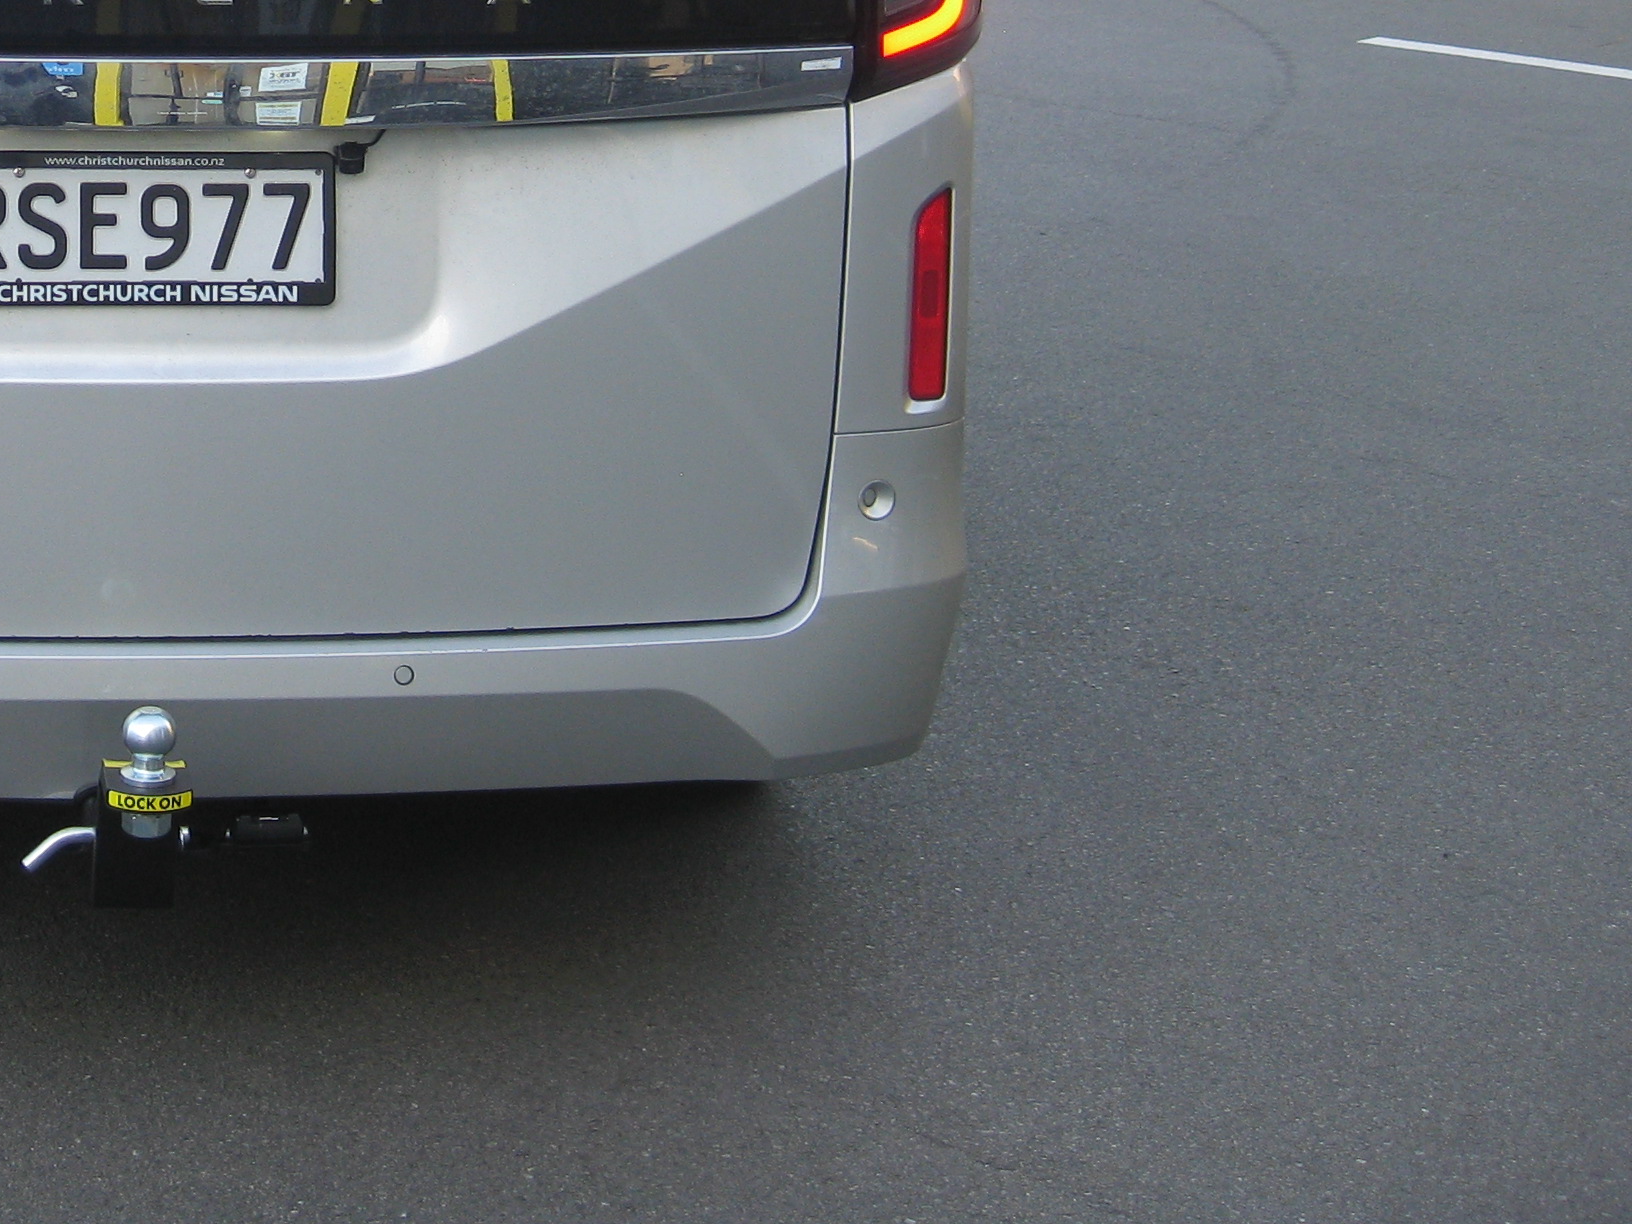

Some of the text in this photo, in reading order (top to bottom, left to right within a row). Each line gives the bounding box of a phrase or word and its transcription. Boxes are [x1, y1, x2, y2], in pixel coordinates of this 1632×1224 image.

[44, 156, 225, 167] www.christchurchnissan.co.nz
[191, 284, 298, 302] NISSAN
[117, 794, 183, 810] LOCK ON
